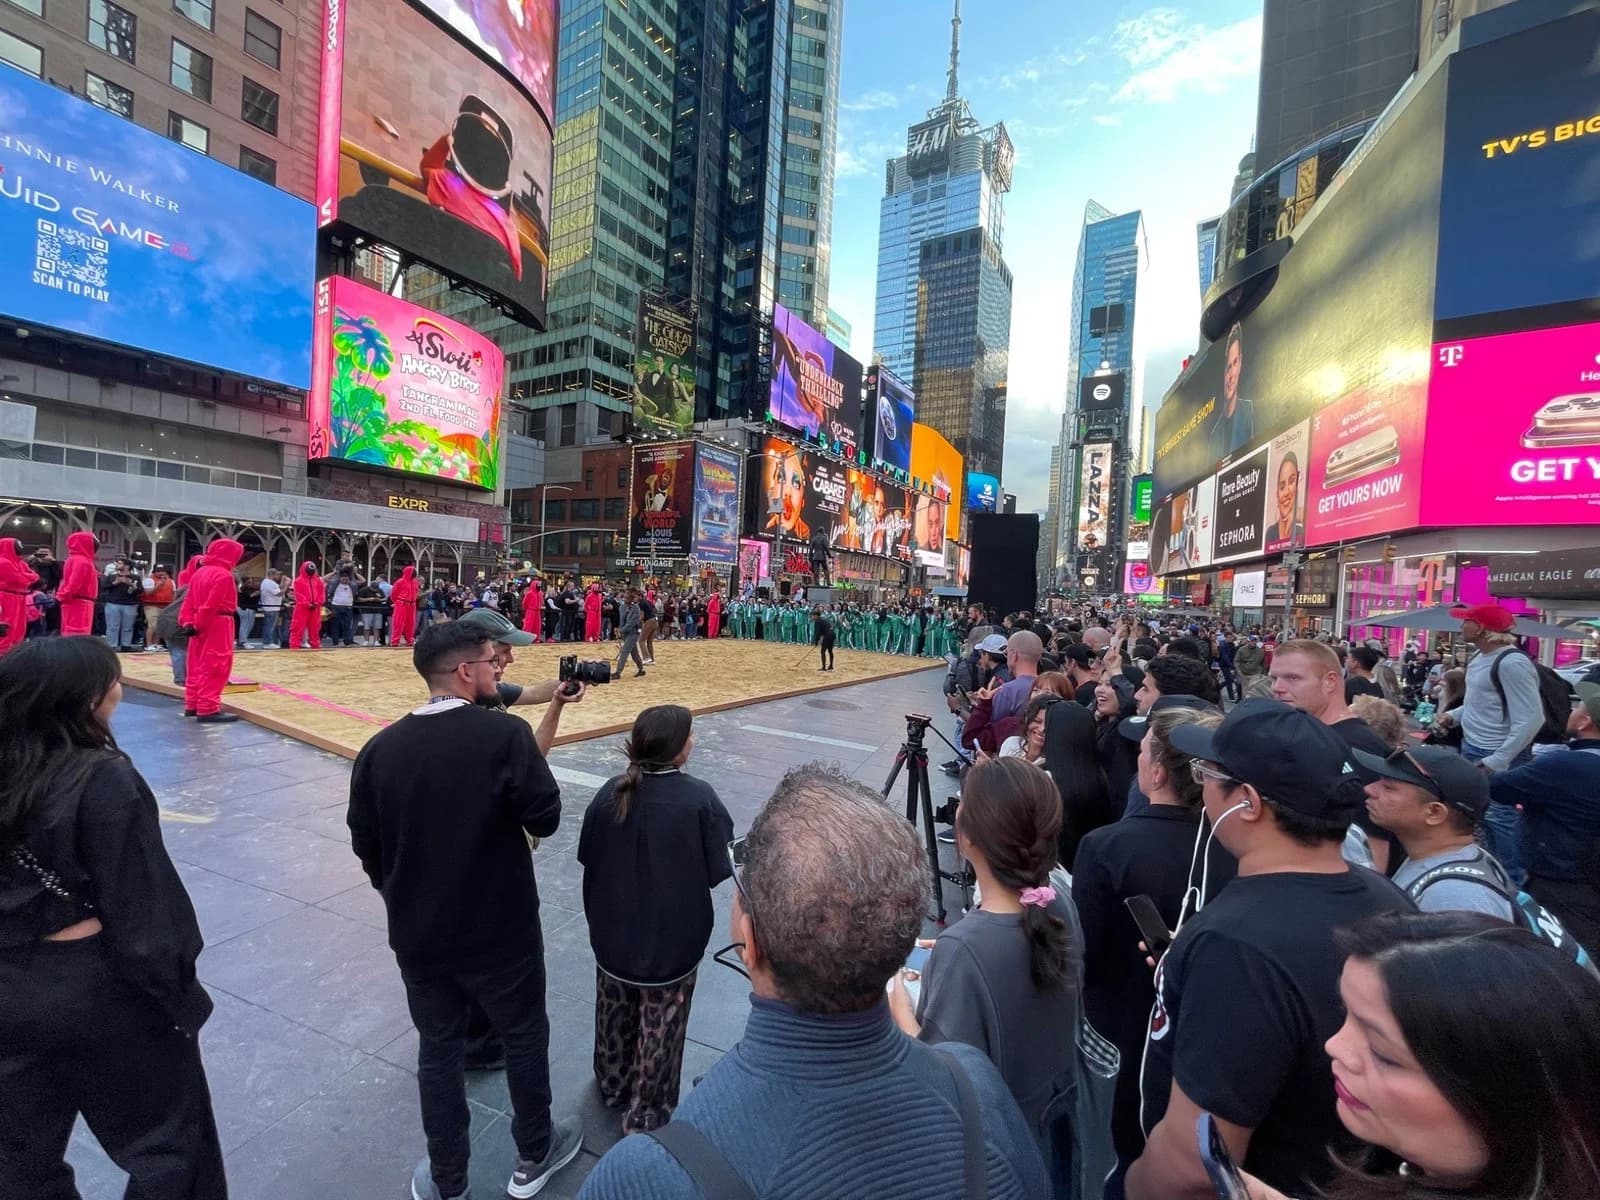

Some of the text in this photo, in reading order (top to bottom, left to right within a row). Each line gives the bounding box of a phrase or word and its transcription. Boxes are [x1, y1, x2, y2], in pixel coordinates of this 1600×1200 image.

[1482, 130, 1546, 159] TV'S
[89, 166, 180, 213] WALKER
[72, 206, 170, 250] GAME
[33, 271, 110, 303] SCAN TO PLAY
[400, 353, 480, 396] ANGRY BIRDS
[401, 384, 456, 411] TANGRAM
[399, 400, 420, 413] 2ND
[439, 410, 461, 426] FOOD
[1236, 468, 1260, 491] Beauty
[1510, 459, 1581, 482] GET
[812, 477, 846, 499] CABARET
[1087, 452, 1103, 524] LAZZA
[1318, 473, 1403, 514] GET YOURS NOW
[644, 518, 676, 528] WORLD
[1219, 523, 1255, 548] SEPHORA
[616, 559, 674, 568] GIFTS LUGGAGE
[1487, 569, 1573, 583] AMERICAN EAGLE
[1295, 593, 1327, 604] SEPHORA
